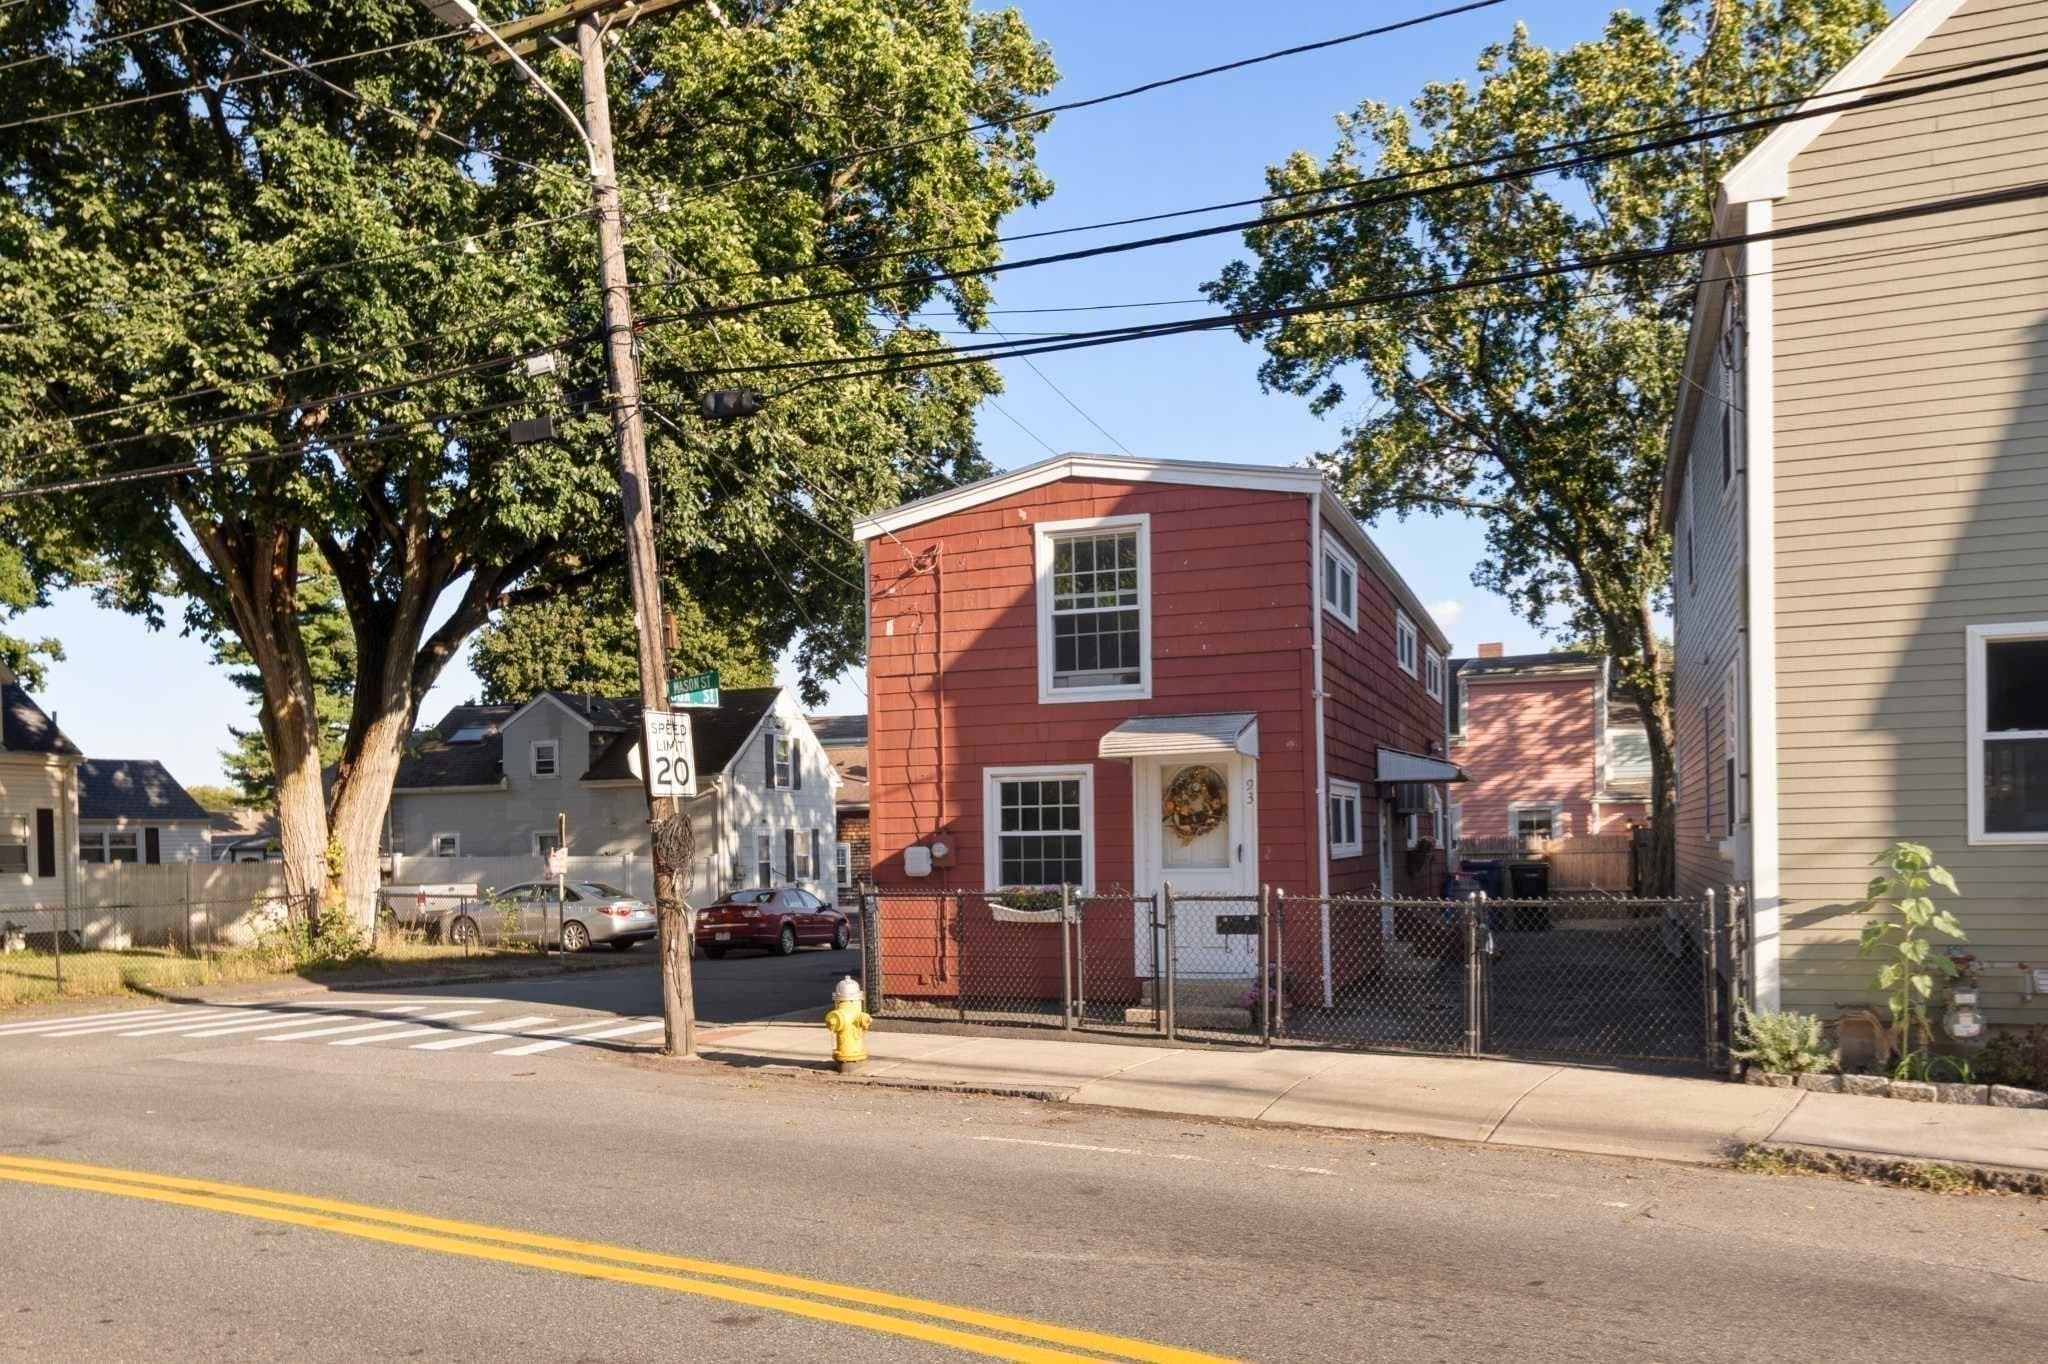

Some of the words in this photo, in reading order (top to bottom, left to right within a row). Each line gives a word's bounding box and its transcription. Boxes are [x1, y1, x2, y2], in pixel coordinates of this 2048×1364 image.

[673, 677, 700, 693] MASON
[700, 675, 711, 689] ST
[650, 722, 687, 736] SPEED
[656, 740, 686, 752] LIMIT
[655, 756, 689, 786] 20
